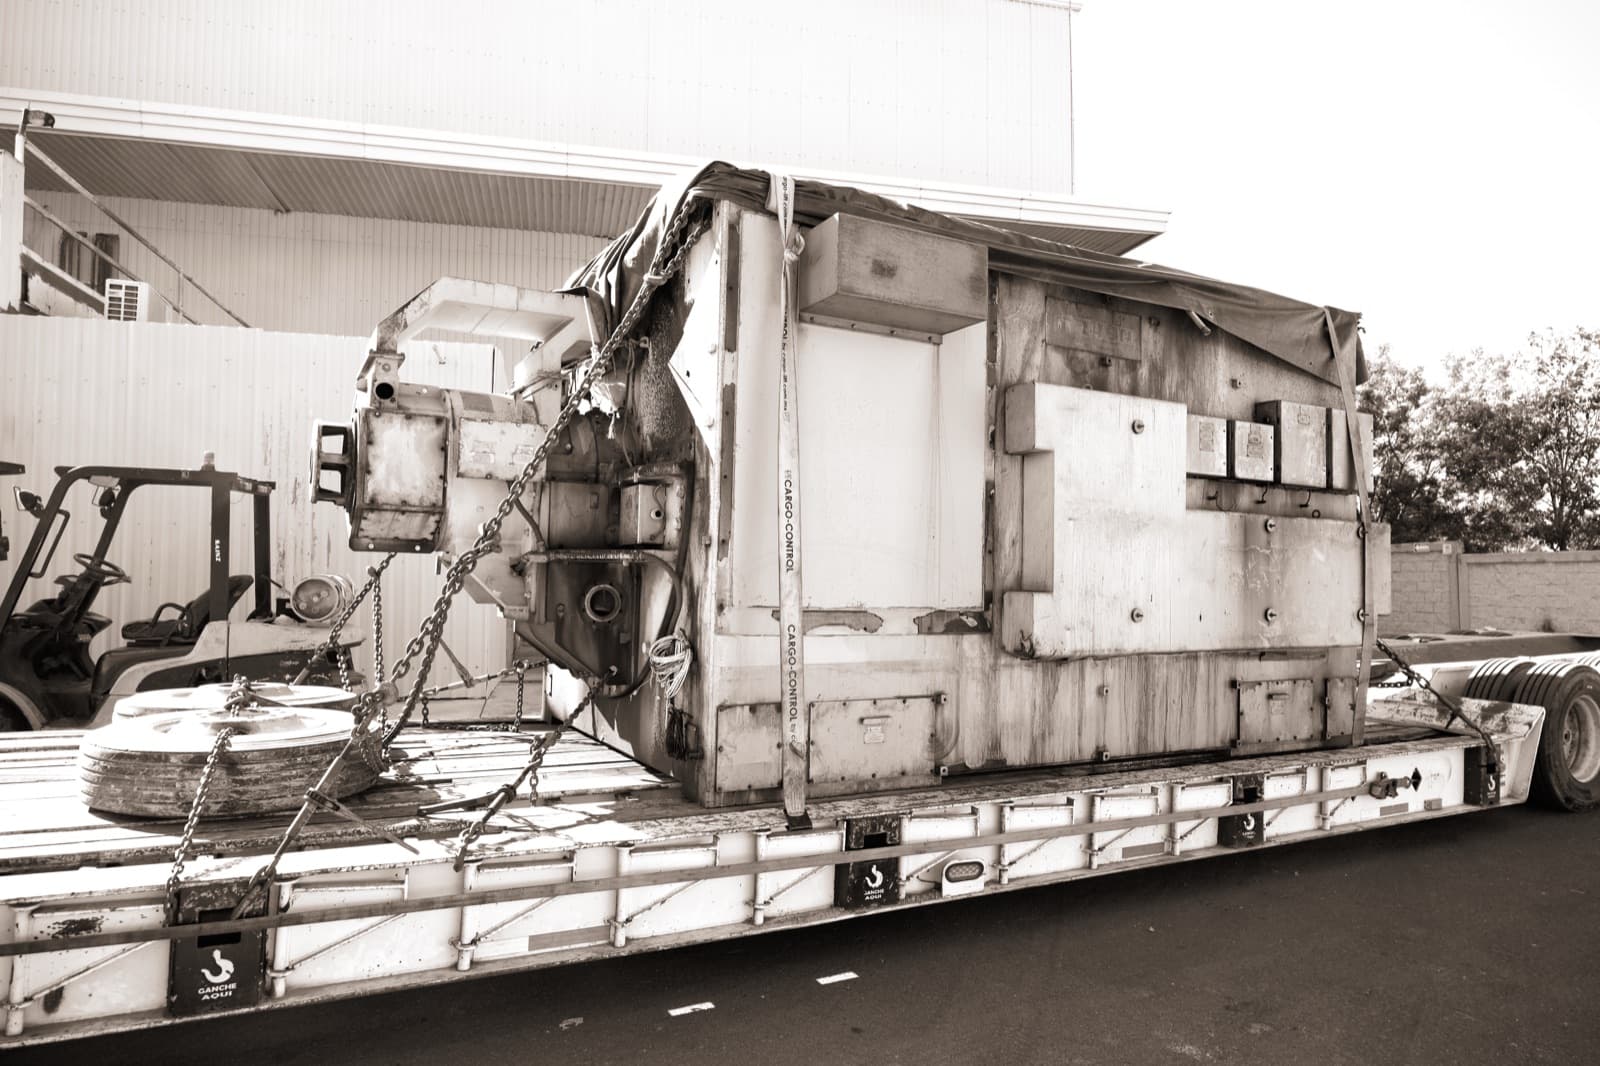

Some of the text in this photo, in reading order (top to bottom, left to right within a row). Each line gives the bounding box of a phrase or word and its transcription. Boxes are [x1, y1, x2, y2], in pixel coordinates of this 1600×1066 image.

[784, 479, 794, 573] CARGO-CONTROL
[787, 624, 798, 722] CARGO-CONTROL
[198, 982, 237, 995] GANCHE
